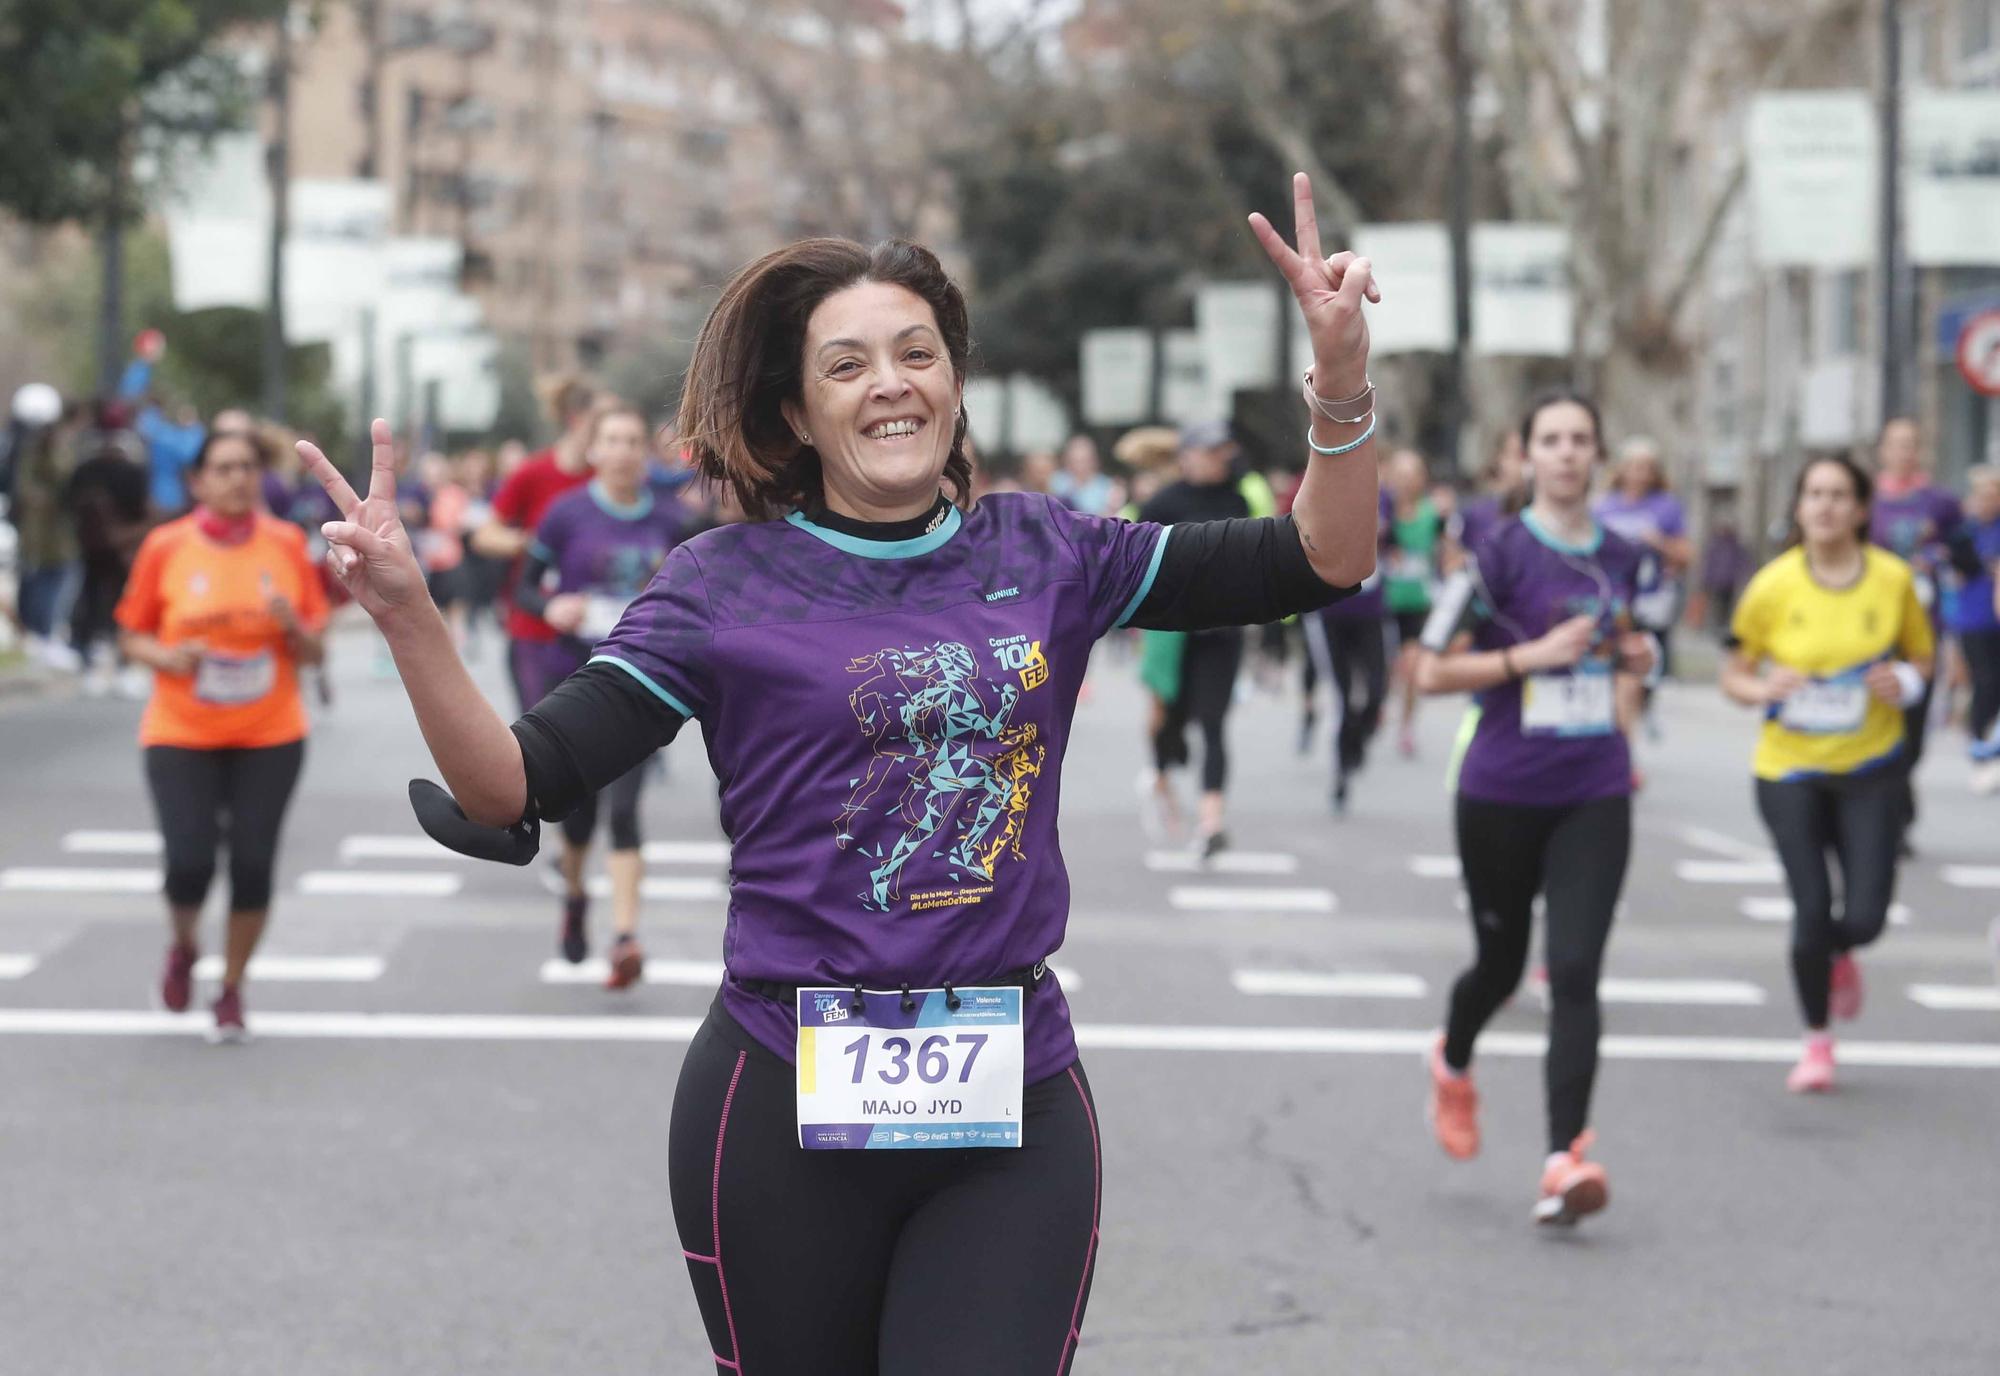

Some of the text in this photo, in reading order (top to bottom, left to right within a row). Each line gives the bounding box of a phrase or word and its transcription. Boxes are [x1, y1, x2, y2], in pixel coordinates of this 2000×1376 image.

[986, 587, 1020, 602] RUNNEK
[989, 634, 1027, 648] Carrera
[993, 641, 1043, 671] 10K
[814, 999, 840, 1012] 10K
[825, 1010, 846, 1022] FEM
[844, 1034, 989, 1085] 1367
[862, 1100, 963, 1115] MAJO JYD
[1005, 1107, 1012, 1116] L
